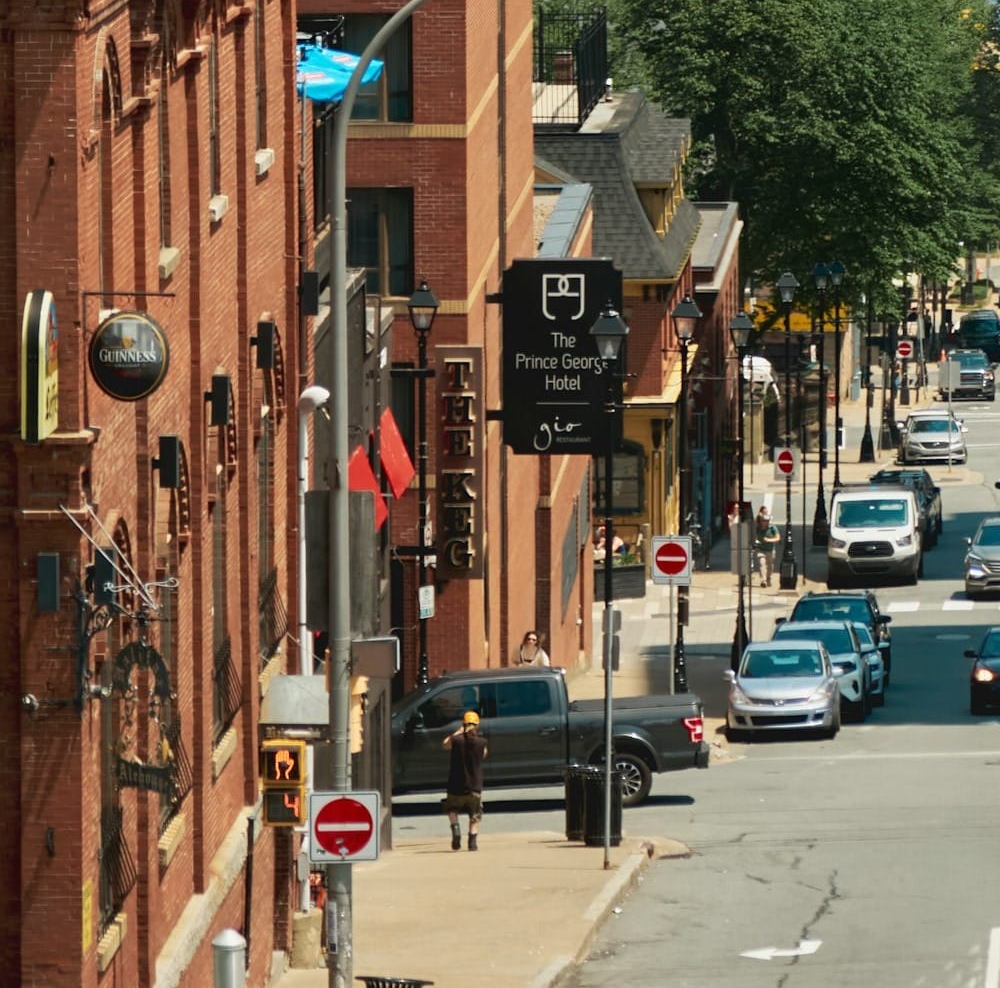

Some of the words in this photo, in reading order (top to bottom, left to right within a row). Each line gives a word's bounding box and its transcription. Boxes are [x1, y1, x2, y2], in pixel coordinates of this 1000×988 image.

[551, 332, 576, 348] The
[99, 348, 157, 363] GUINNESS
[515, 353, 558, 370] Prince
[545, 374, 581, 391] Hotel
[441, 357, 478, 457] THE
[533, 416, 583, 451] gio
[441, 469, 478, 569] KEG
[284, 792, 300, 818] 4
